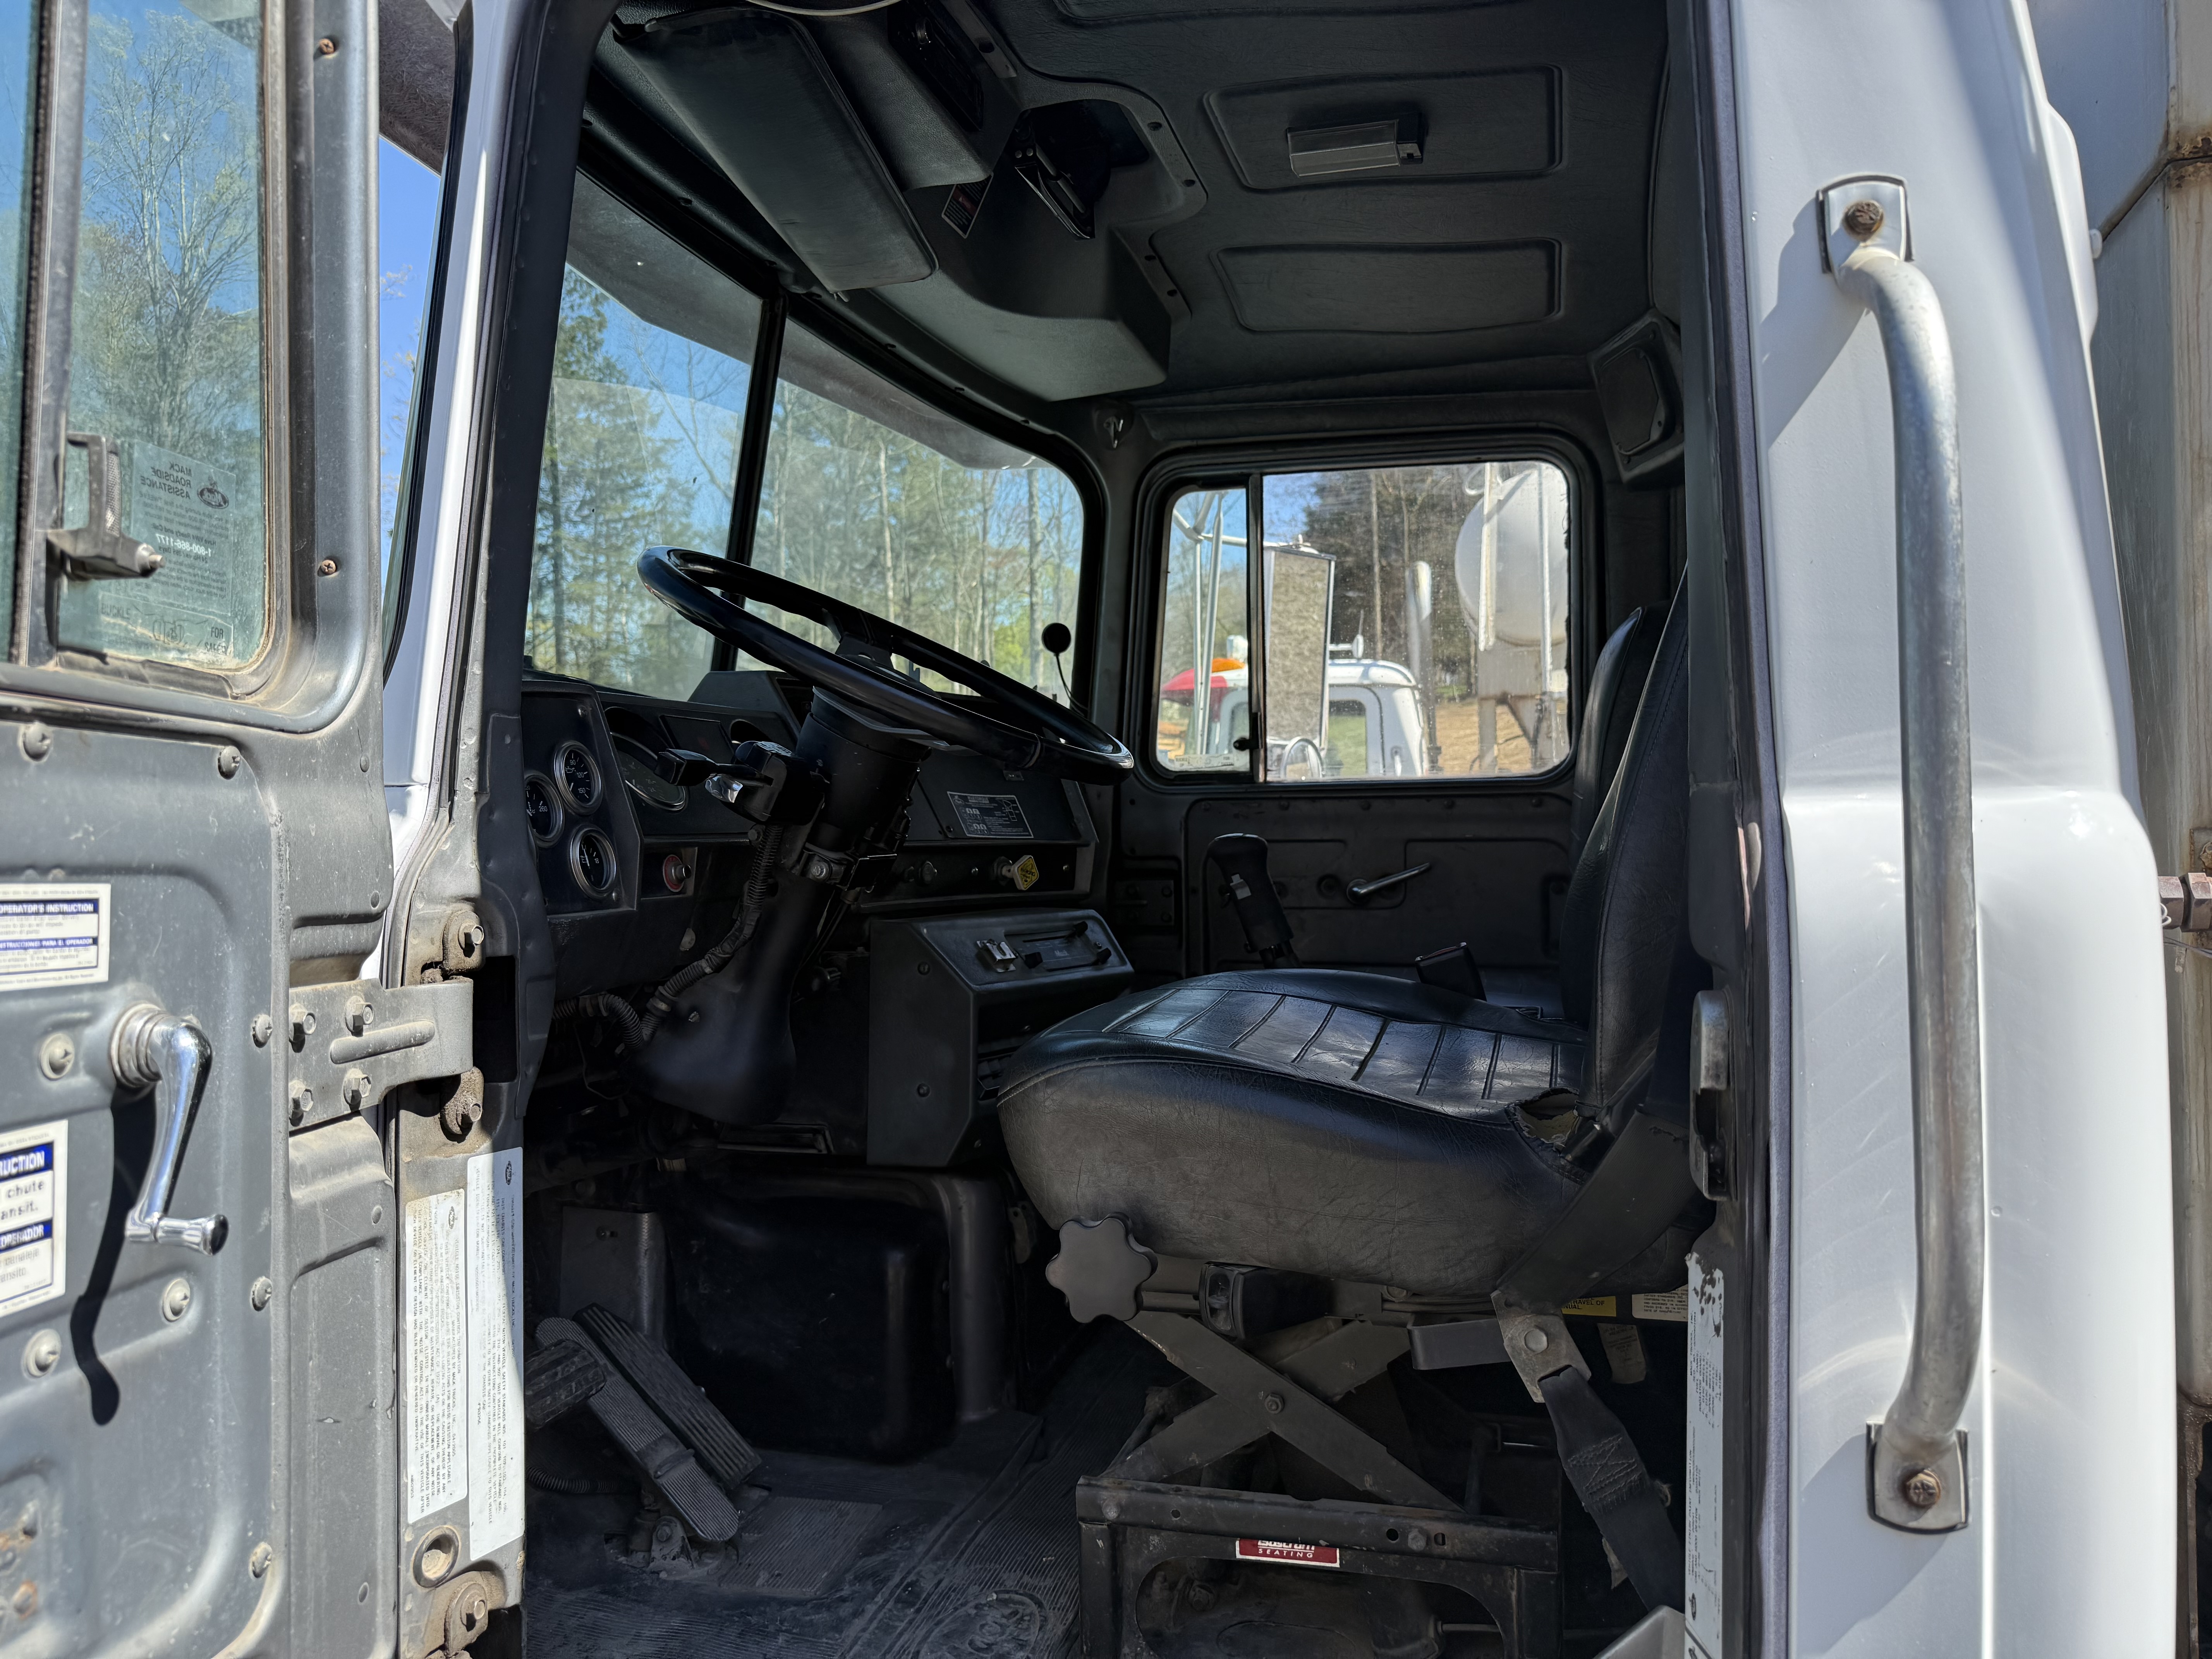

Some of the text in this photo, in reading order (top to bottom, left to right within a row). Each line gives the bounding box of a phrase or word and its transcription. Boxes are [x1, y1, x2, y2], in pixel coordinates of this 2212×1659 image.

[101, 603, 131, 620] BUCKLE
[211, 627, 224, 639] FOR
[0, 903, 94, 914] OPERATOR'S INSTRUCTION
[7, 1180, 45, 1199] chute
[1259, 1549, 1313, 1558] SEATING
